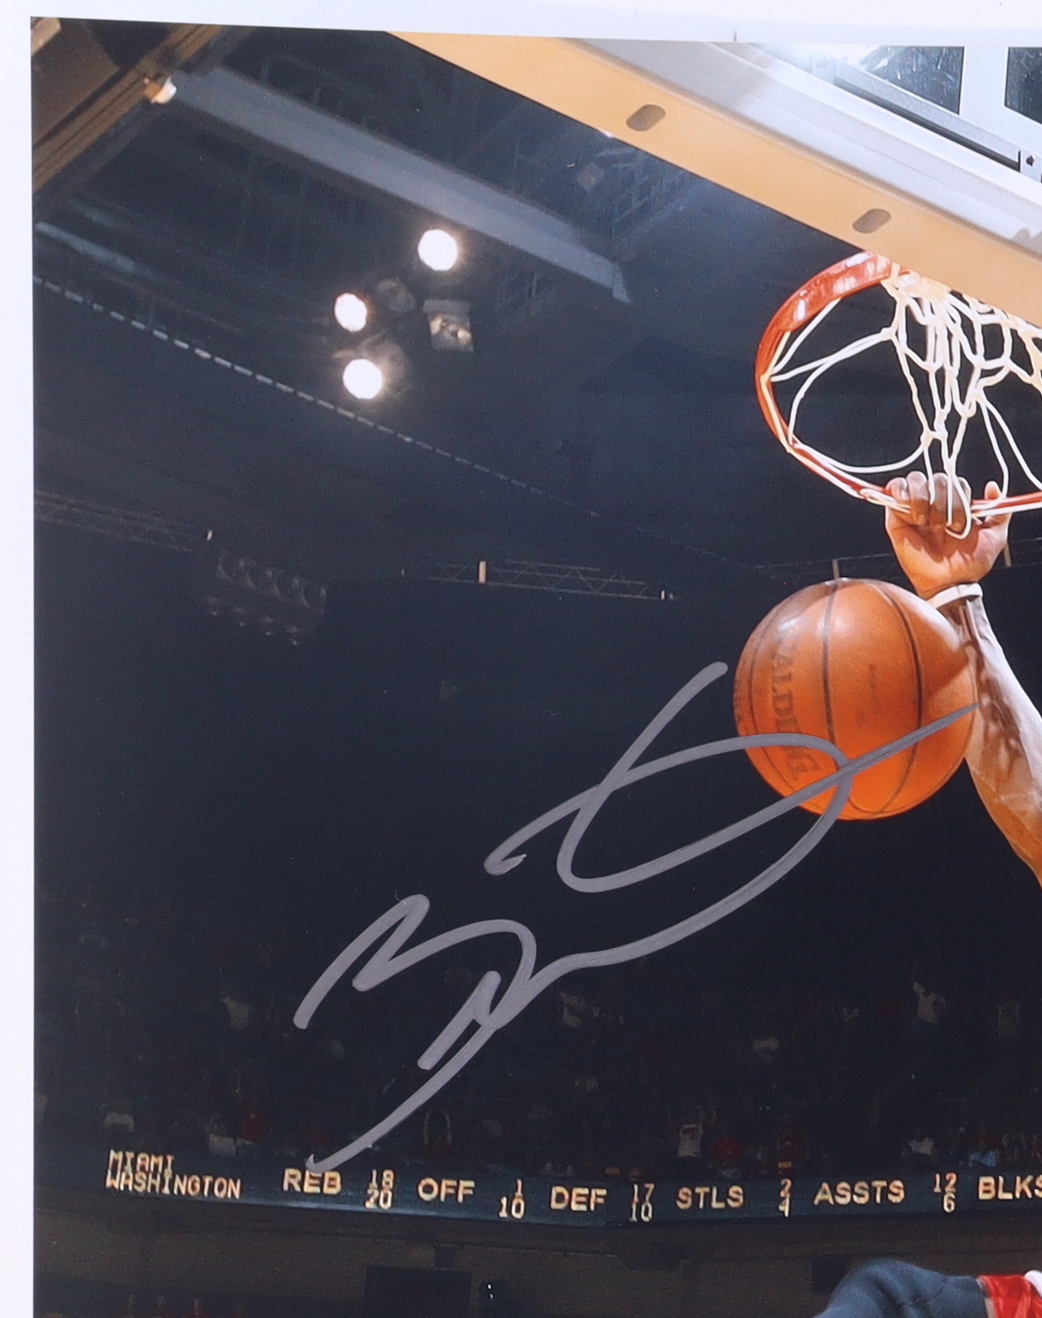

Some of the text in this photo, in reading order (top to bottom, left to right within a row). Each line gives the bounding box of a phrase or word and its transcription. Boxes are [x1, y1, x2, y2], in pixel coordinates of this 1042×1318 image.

[107, 1149, 175, 1174] MIAMI
[105, 1169, 242, 1200] WASHINGTON
[282, 1168, 343, 1195] REB
[369, 1169, 395, 1190] 18
[417, 1178, 476, 1203] OFF
[933, 1172, 958, 1194] 12
[364, 1189, 394, 1210] 20
[549, 1185, 608, 1212] DEF
[631, 1183, 655, 1204] 17
[675, 1185, 745, 1210] STLS
[813, 1180, 905, 1206] ASSTS
[942, 1192, 956, 1213] 6
[499, 1197, 525, 1219] 10
[629, 1202, 653, 1222] 10
